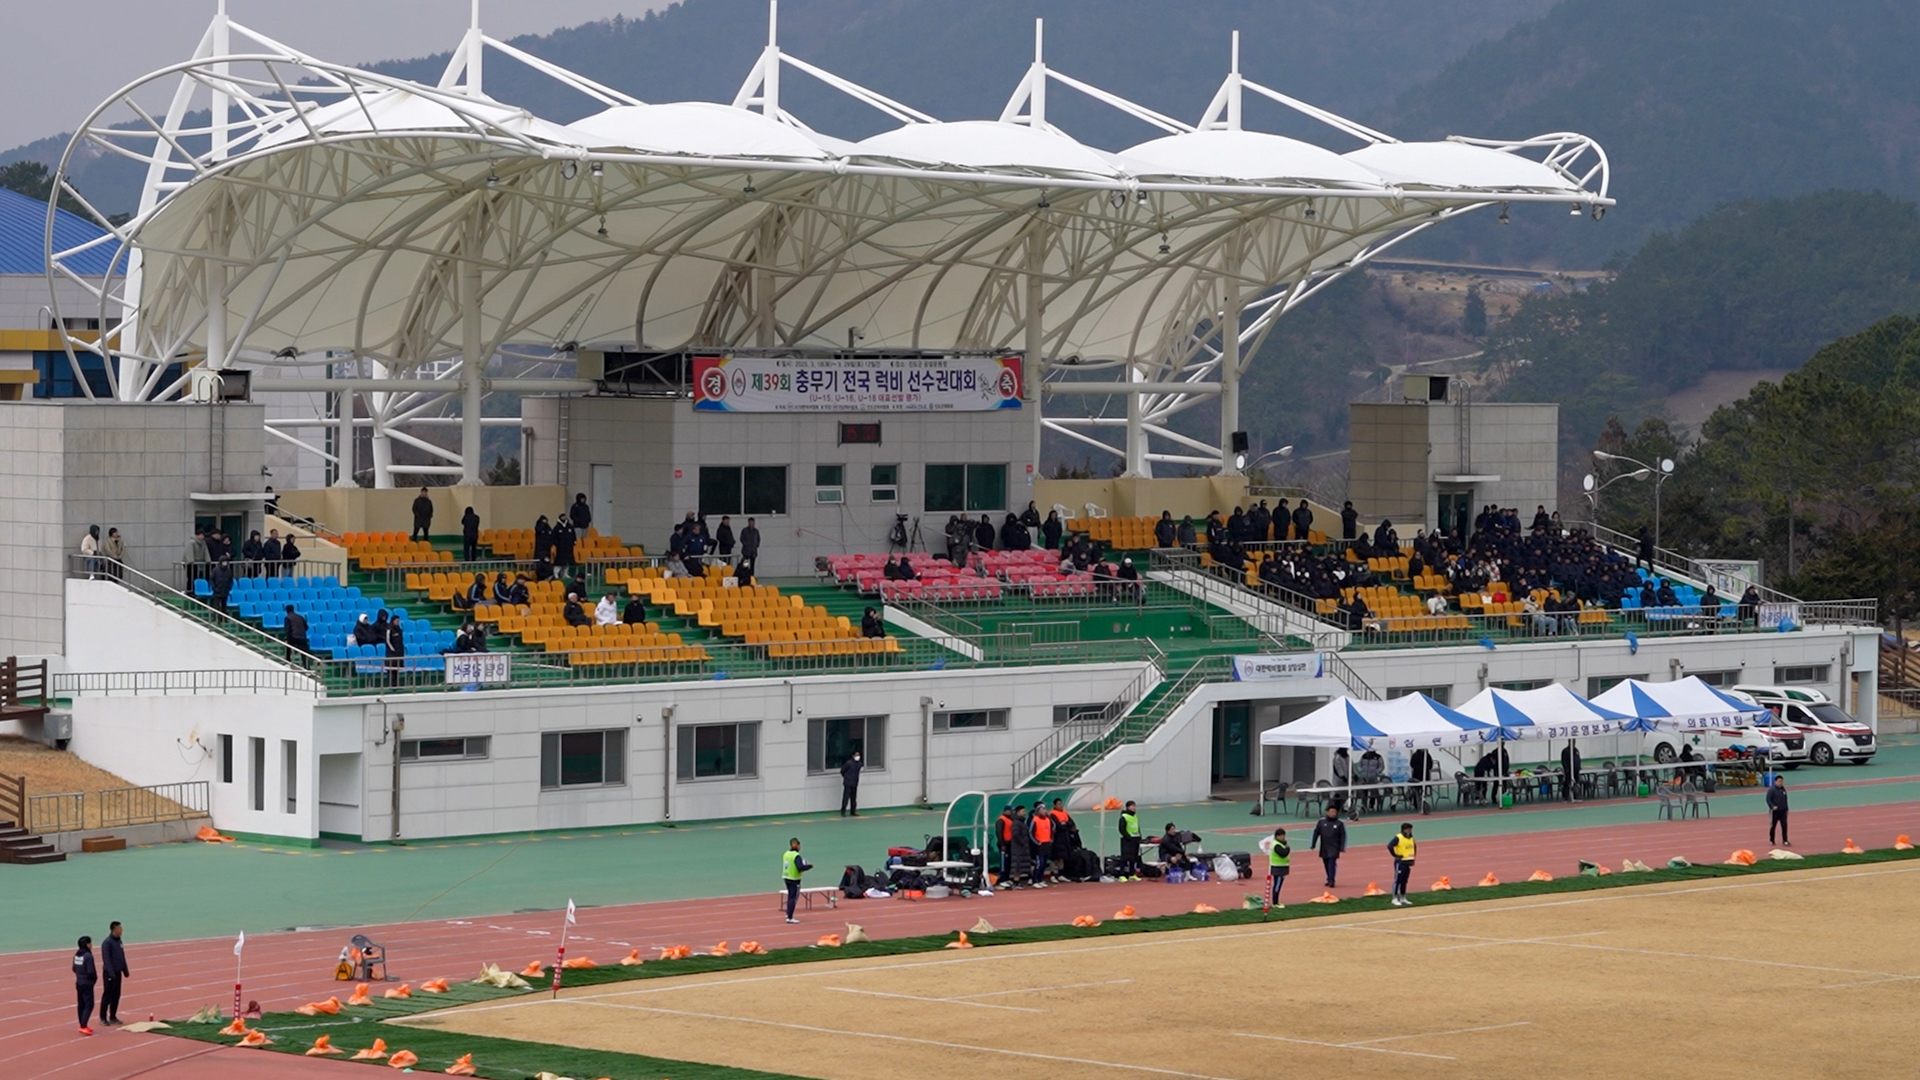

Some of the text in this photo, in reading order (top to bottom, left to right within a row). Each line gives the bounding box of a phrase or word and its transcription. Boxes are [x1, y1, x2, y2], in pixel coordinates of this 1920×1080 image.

[707, 374, 722, 395] 경
[751, 369, 976, 393] 제39회 충무기 전국 럭비 선수권대회
[1002, 374, 1012, 393] 축
[1548, 723, 1611, 738] 경기운영본부
[1687, 715, 1743, 728] 의료지원팀
